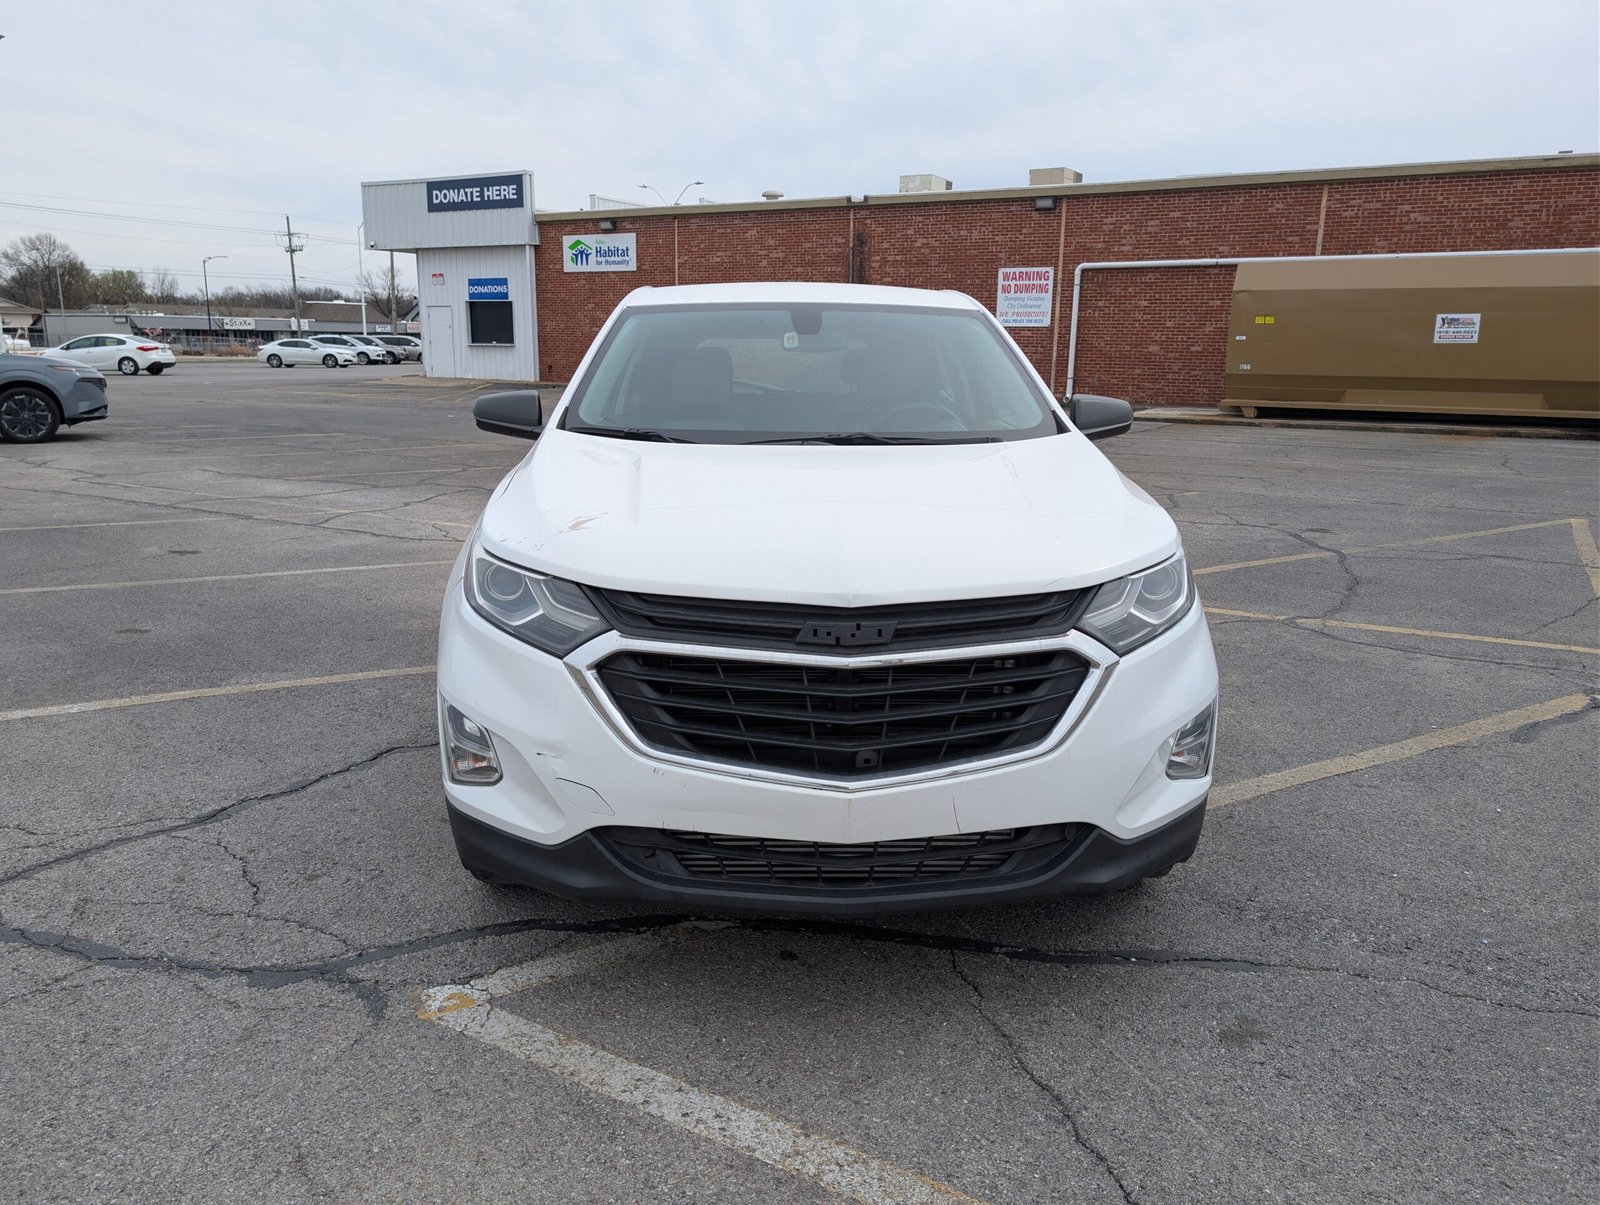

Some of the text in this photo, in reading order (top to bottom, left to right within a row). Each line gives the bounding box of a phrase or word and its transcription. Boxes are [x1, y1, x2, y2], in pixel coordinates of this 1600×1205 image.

[432, 184, 517, 204] DONATE HERE
[595, 246, 630, 258] Habitat
[604, 259, 630, 267] Humanity
[1002, 271, 1050, 281] WARNING
[469, 285, 508, 294] DONATIONS
[1002, 283, 1049, 294] NO DUMPING
